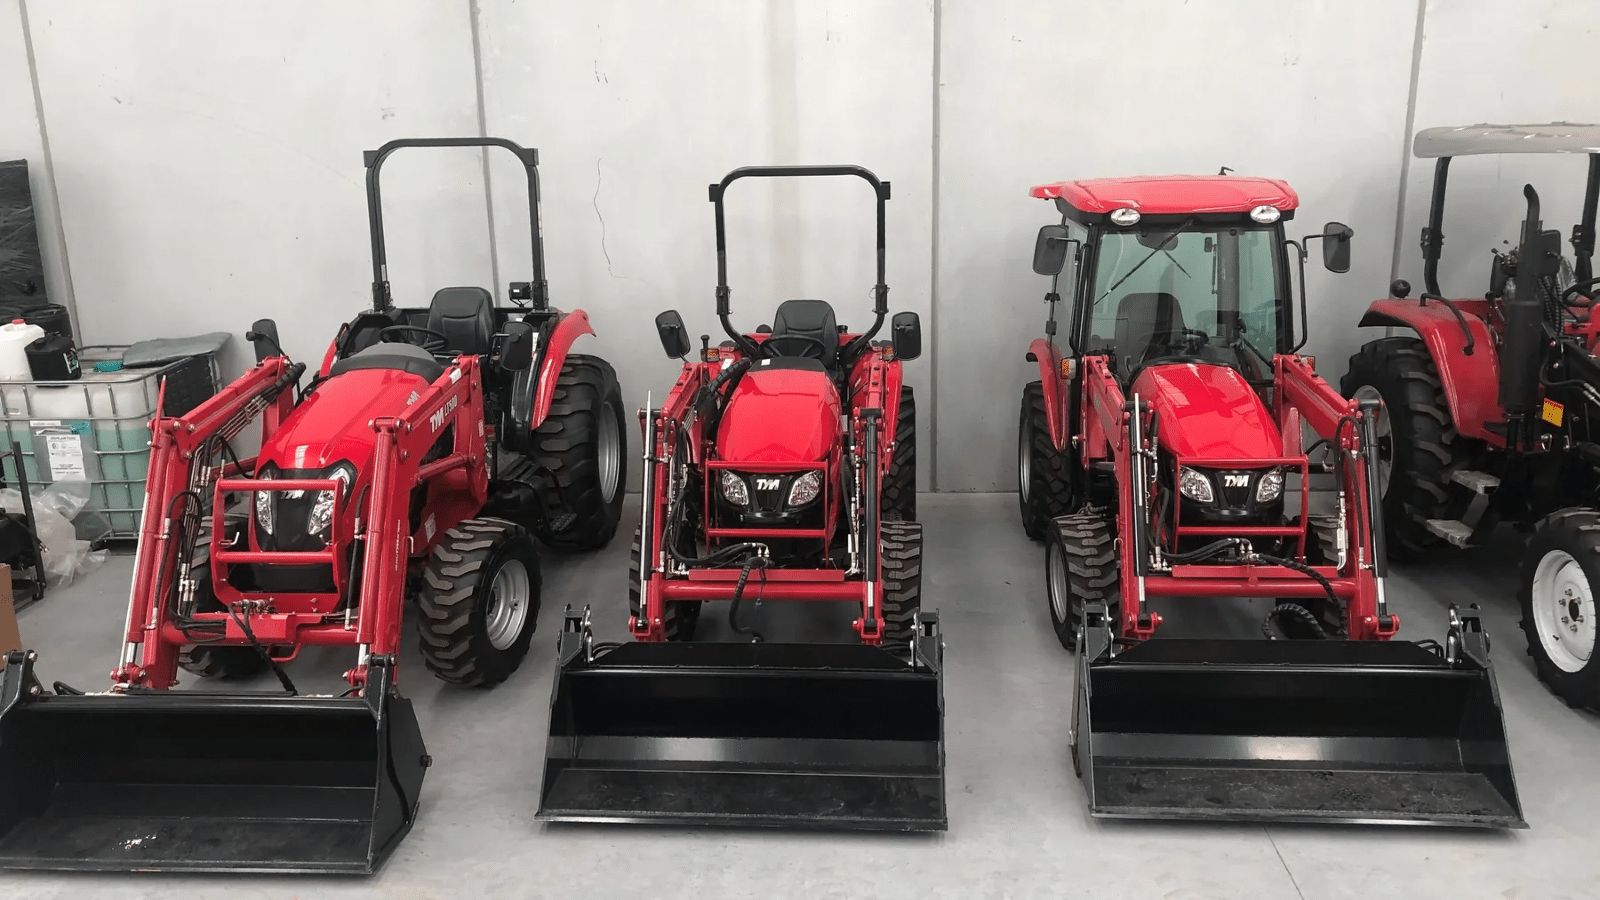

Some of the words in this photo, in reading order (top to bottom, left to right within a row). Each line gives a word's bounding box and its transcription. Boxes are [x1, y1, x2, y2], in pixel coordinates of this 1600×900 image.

[430, 406, 444, 433] TYM
[756, 478, 781, 491] TYM
[1224, 474, 1250, 488] TYM
